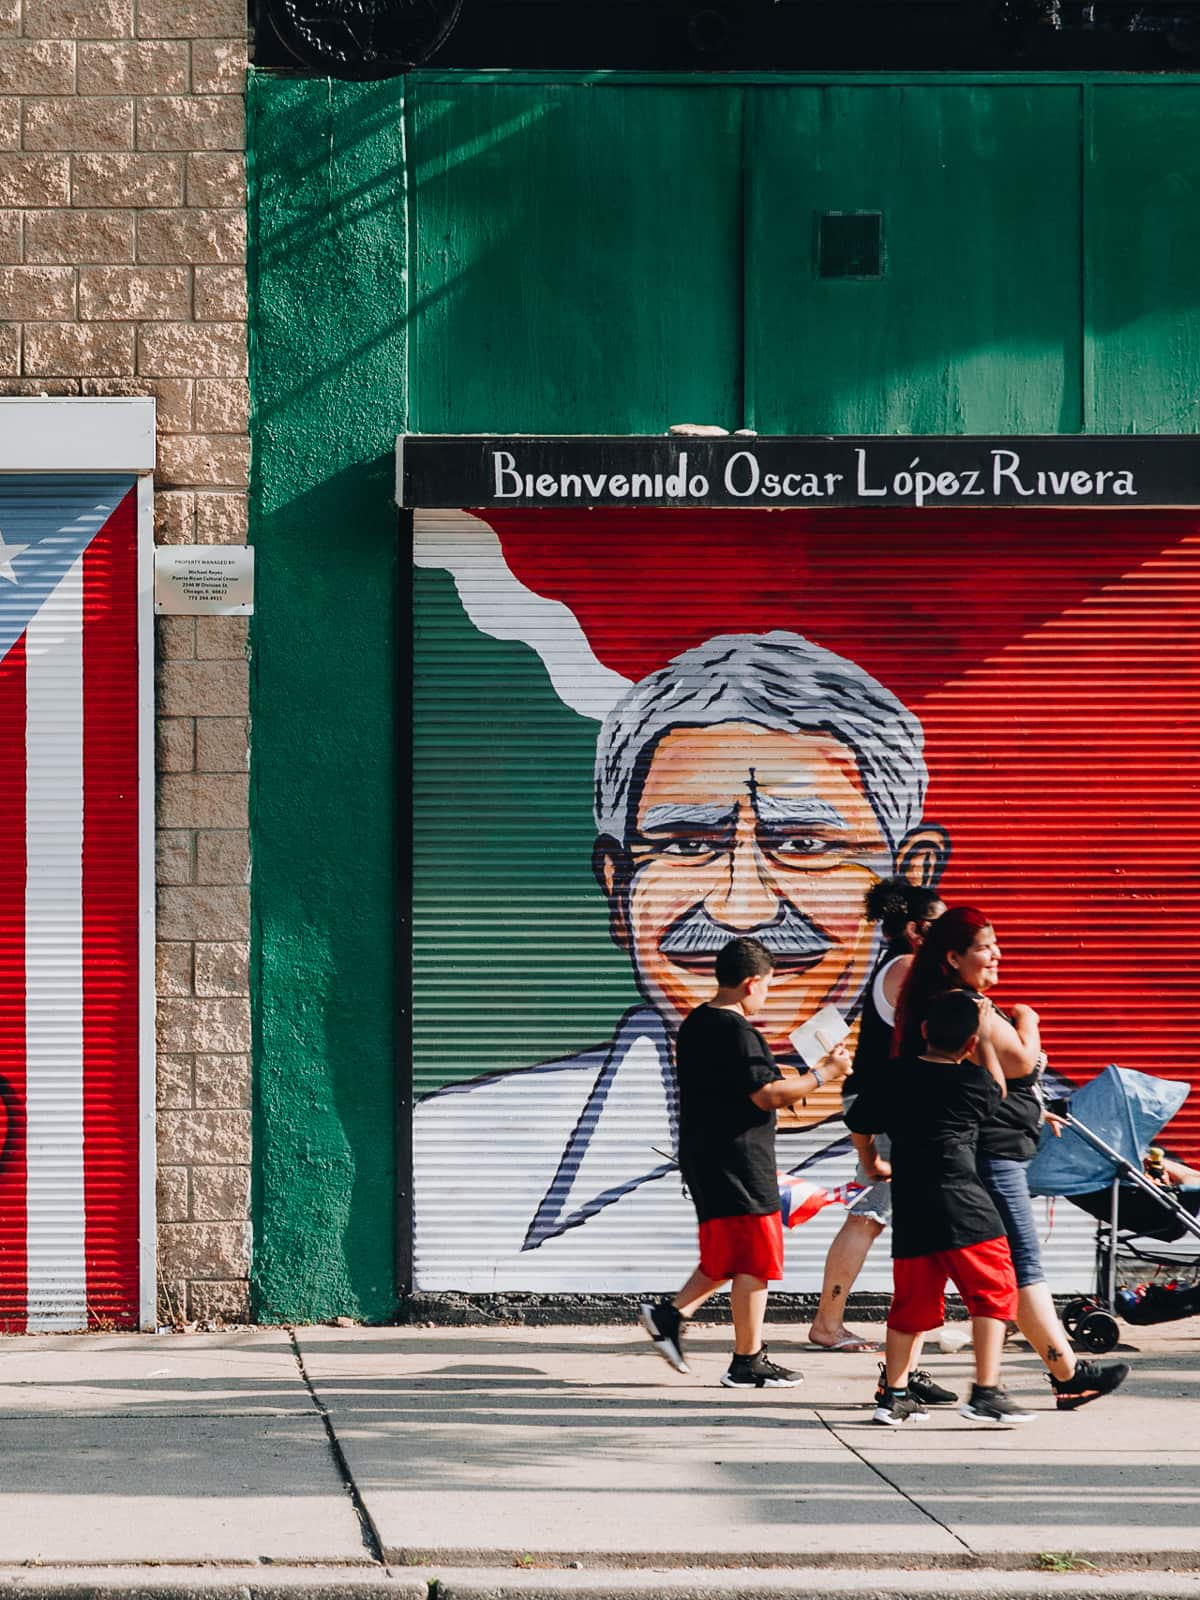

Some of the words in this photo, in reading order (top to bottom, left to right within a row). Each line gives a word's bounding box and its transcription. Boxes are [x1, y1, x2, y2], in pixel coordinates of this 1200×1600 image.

[492, 450, 710, 498] Bienvenido
[724, 450, 845, 497] Oscar
[854, 448, 985, 507] López
[990, 449, 1138, 497] Rivera
